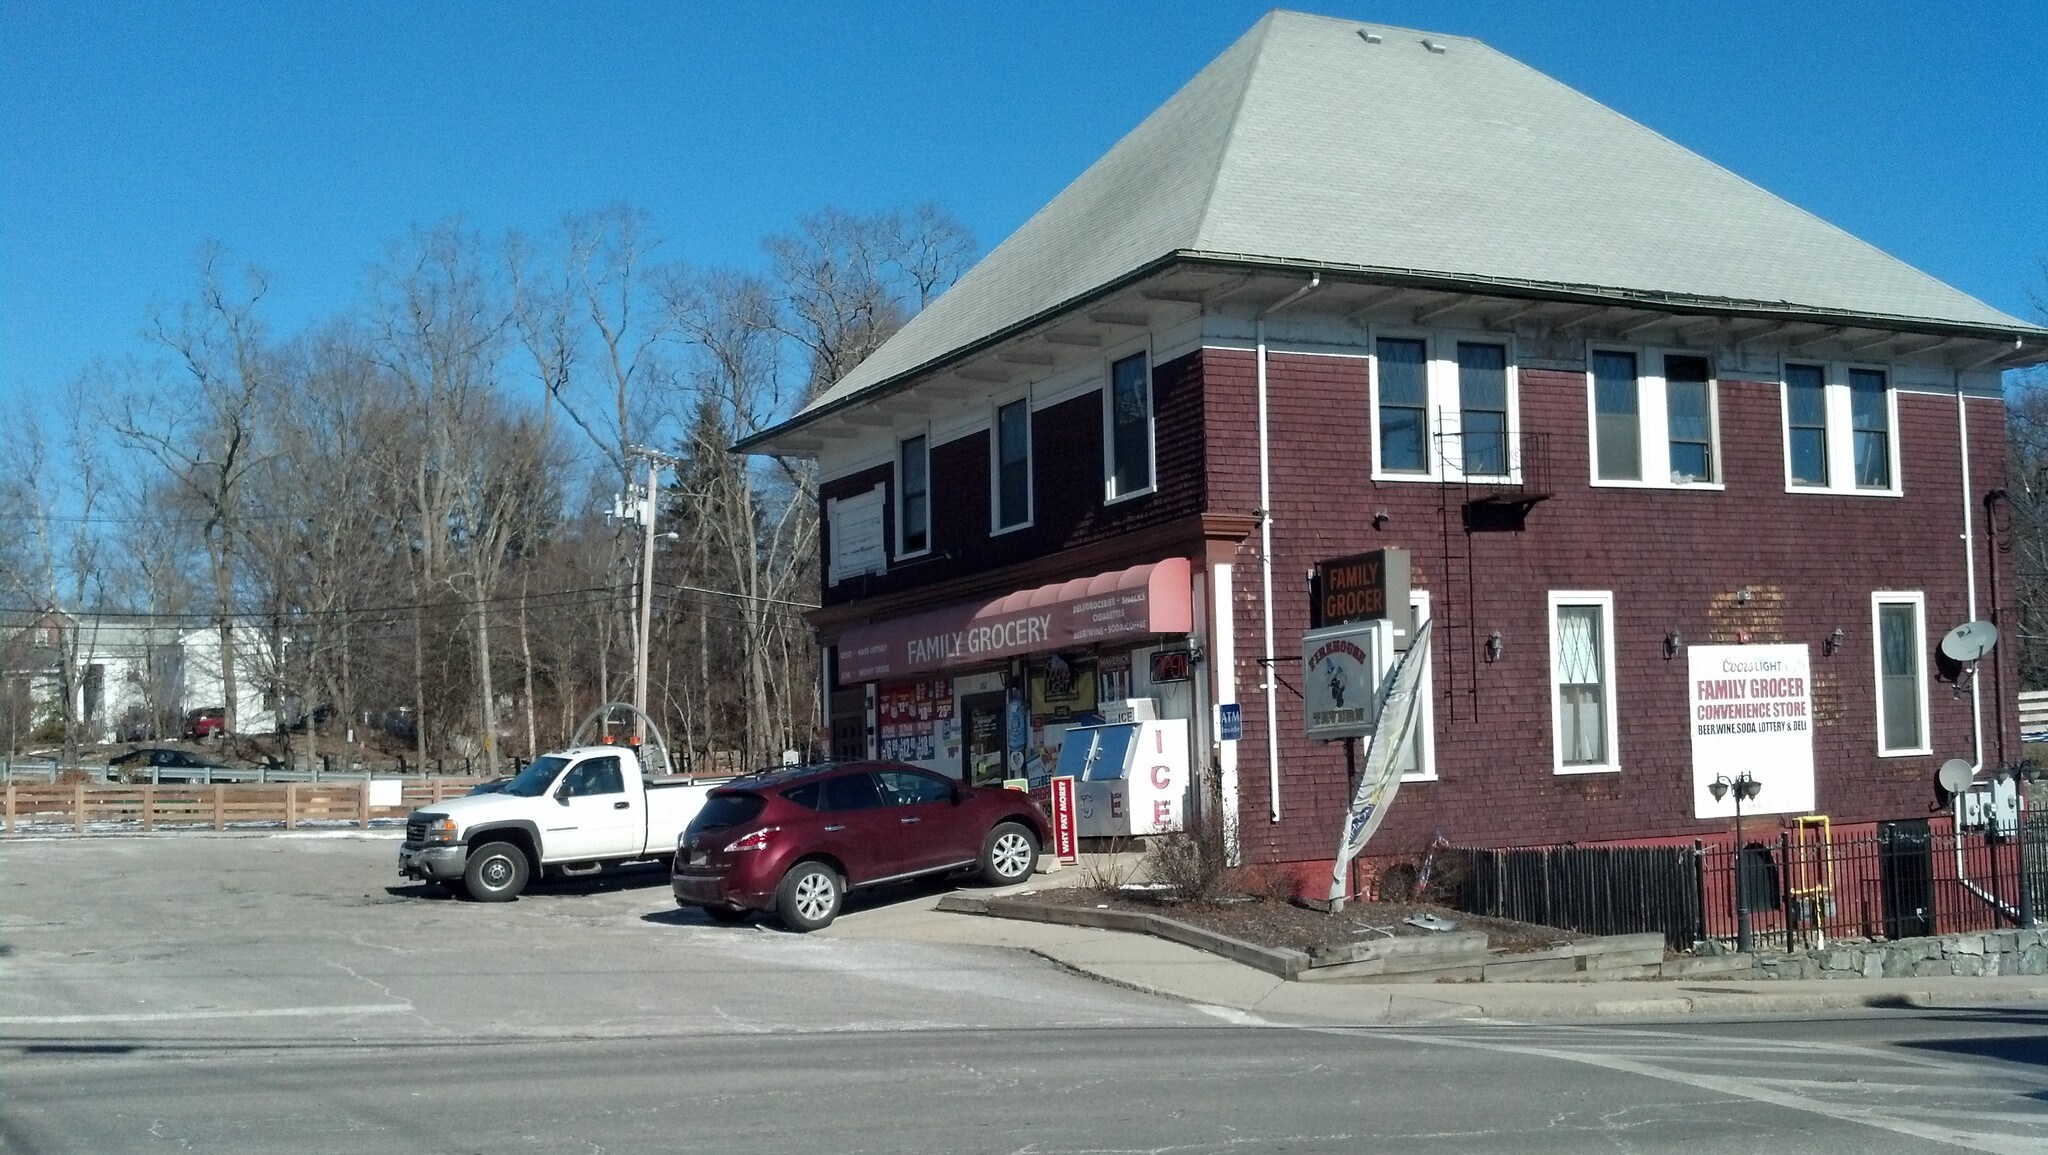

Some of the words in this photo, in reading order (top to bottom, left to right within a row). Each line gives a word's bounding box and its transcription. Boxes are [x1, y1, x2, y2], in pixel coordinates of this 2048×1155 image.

[1330, 562, 1379, 590] FAMILY
[1326, 589, 1384, 617] GROCER
[907, 631, 963, 665] FAMILY
[967, 614, 1051, 654] GROCERY
[1153, 655, 1187, 678] OPEN
[1754, 661, 1782, 672] LIGHT
[1697, 679, 1747, 701] FAMILY
[1750, 677, 1805, 699] GROCER
[1118, 712, 1133, 724] ICE
[1221, 712, 1240, 724] ATM
[1313, 708, 1364, 725] TAVERN
[1697, 702, 1771, 721] CONVENIENCE
[1773, 701, 1807, 718] STORE
[1221, 726, 1240, 734] Inside
[1758, 721, 1786, 733] LOTTERY
[1793, 720, 1807, 731] DELI
[1060, 813, 1068, 830] PAY
[1061, 832, 1070, 853] WHY
